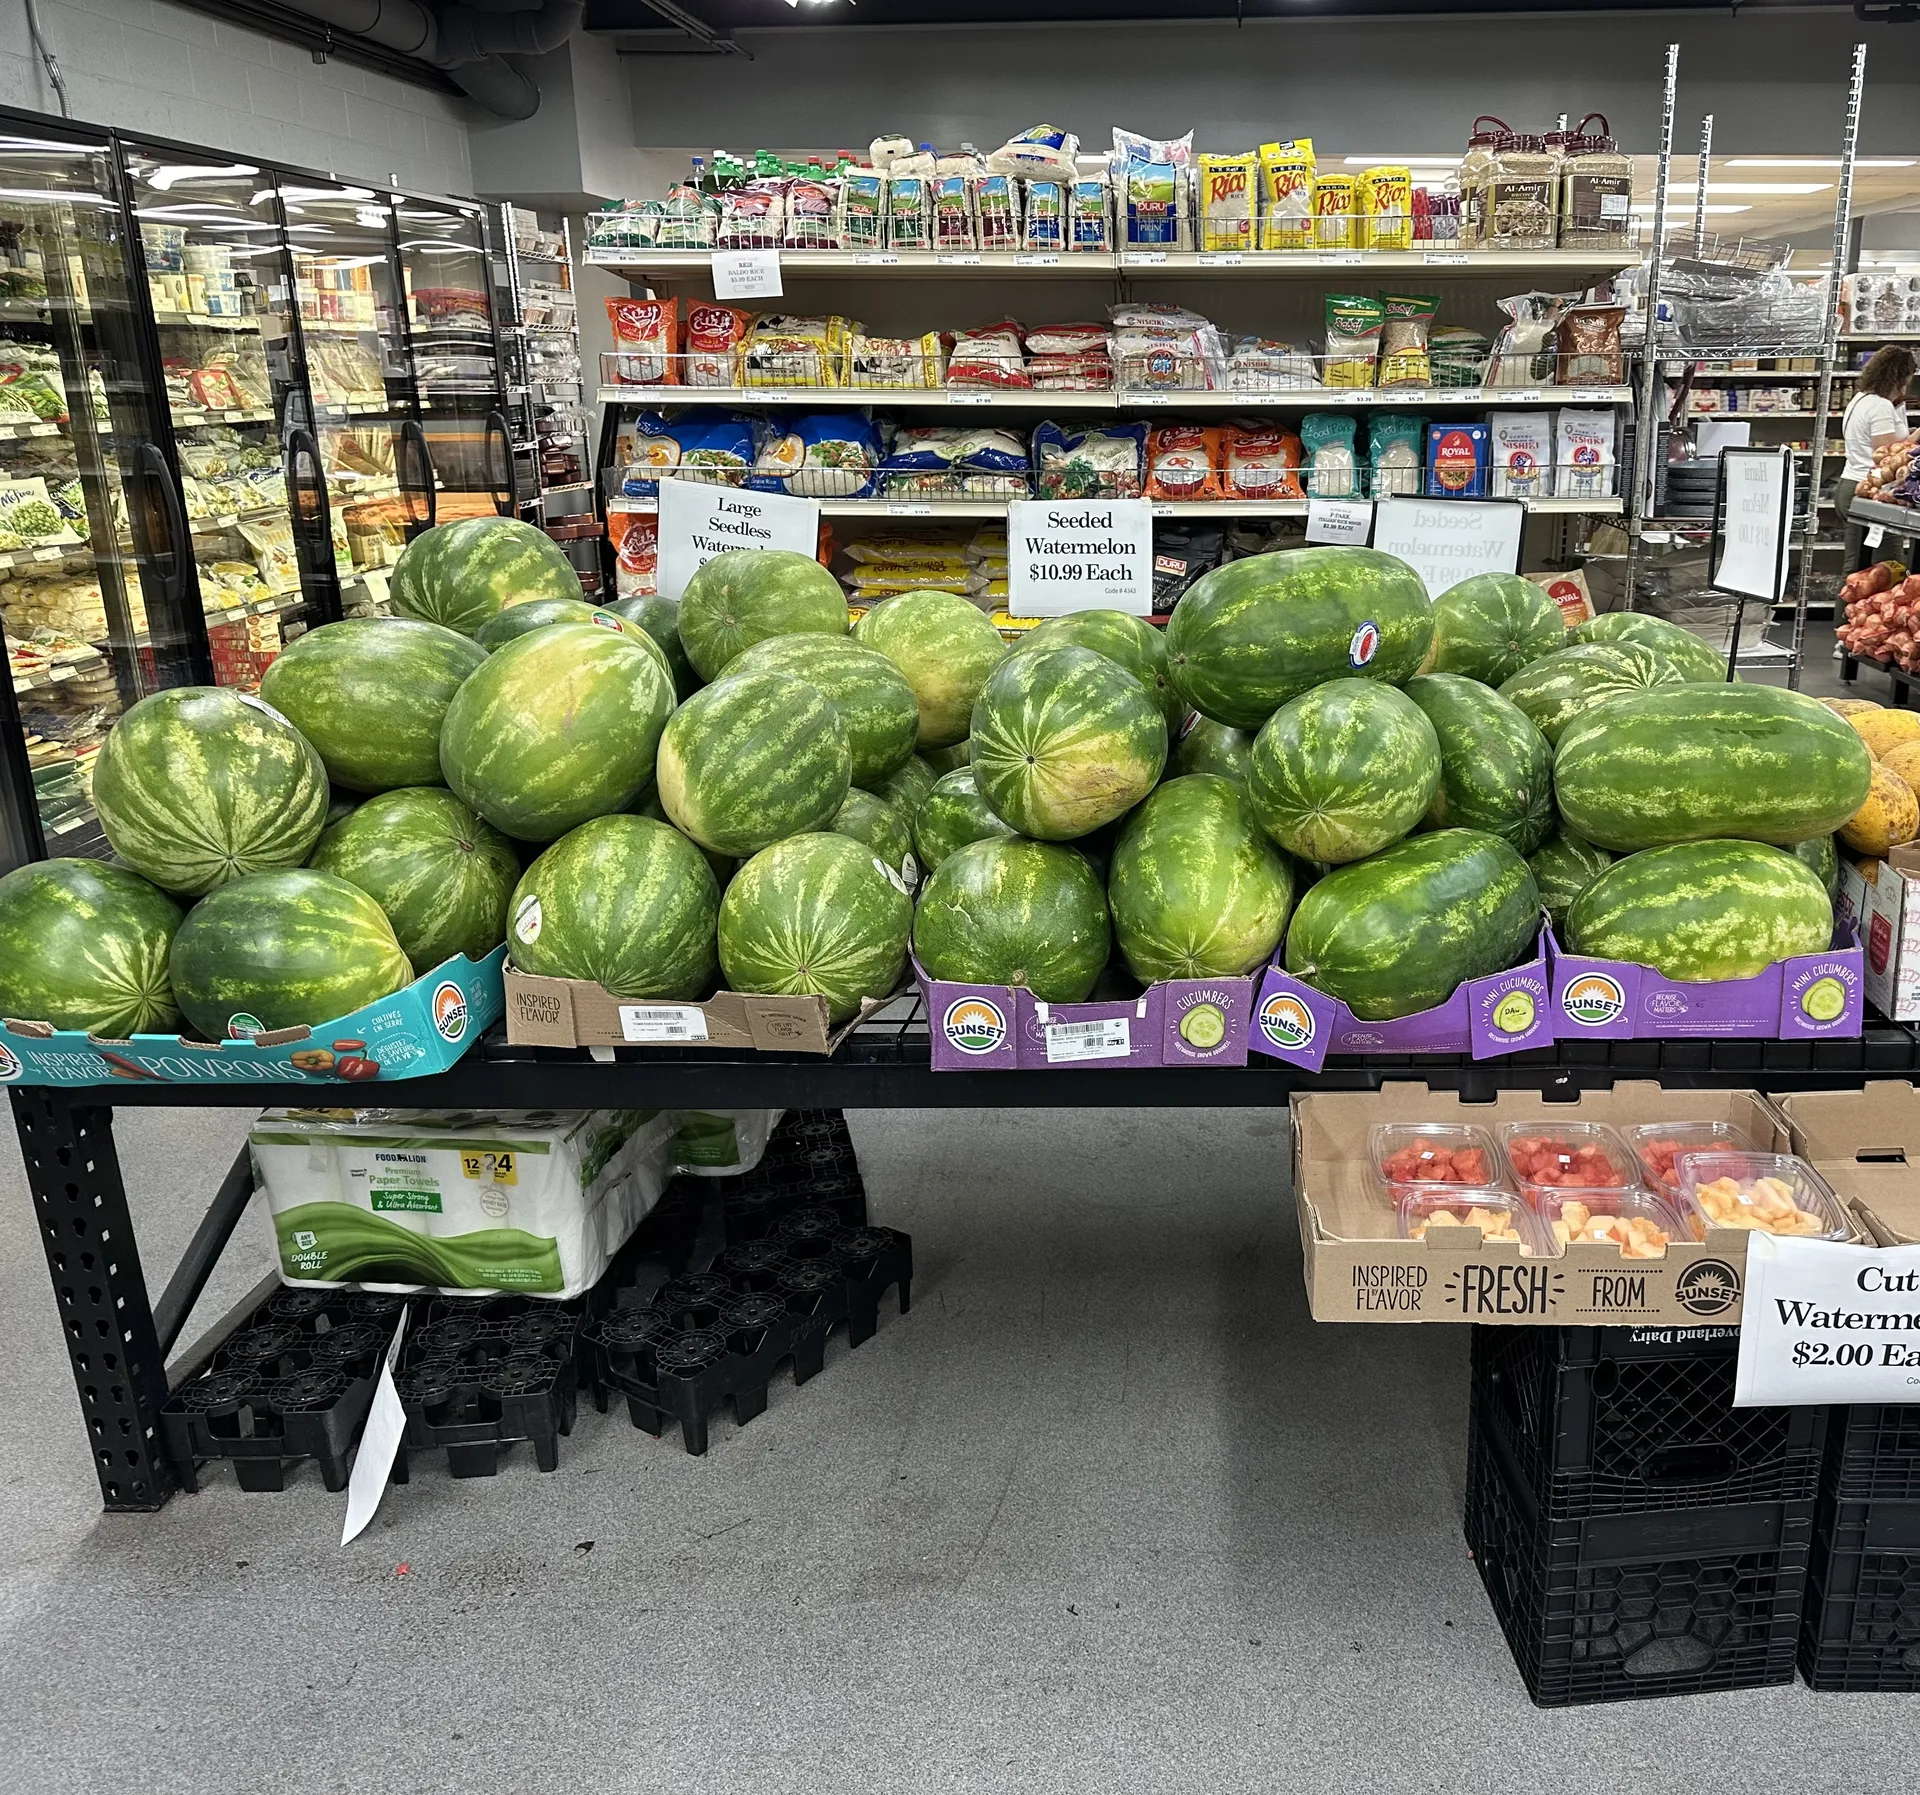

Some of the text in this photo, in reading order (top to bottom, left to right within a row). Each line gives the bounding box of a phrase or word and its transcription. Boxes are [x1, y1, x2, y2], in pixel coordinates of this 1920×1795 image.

[1210, 173, 1247, 203] Rico
[1374, 184, 1406, 209] Rico
[1504, 185, 1544, 193] Al-Amir
[853, 205, 873, 214] DURU
[1138, 202, 1165, 212] DURU
[1319, 192, 1351, 215] Rico
[1136, 318, 1165, 326] NISHIKI
[1568, 436, 1605, 445] NISHIKI
[1441, 447, 1471, 457] ROYAL
[717, 496, 762, 519] Large
[708, 516, 772, 540] Seedless
[1047, 511, 1113, 528] Seeded
[1025, 537, 1137, 555] Watermelon
[1158, 557, 1185, 571] DURU
[1029, 563, 1083, 583] $10.99
[1085, 563, 1133, 581] Each
[1791, 963, 1858, 991] MINI CUCUMBERS
[516, 991, 561, 1010] INSPIRED
[1177, 990, 1235, 1011] CUCUMBERS
[1482, 976, 1545, 1008] MINI CUCUMBERS
[1563, 998, 1621, 1014] SUNSET
[438, 1003, 468, 1035] SUNSET
[520, 1006, 561, 1024] FLAVOR
[1794, 1015, 1816, 1030] GREENHOUSE
[1830, 1010, 1851, 1029] GOODNESS
[373, 1017, 404, 1033] EN SERRE
[946, 1023, 1005, 1040] SUNSET
[1259, 1013, 1312, 1045] SUNSET
[1487, 1019, 1542, 1043] GREENHOUSE GROWN GOODNESS
[26, 1050, 106, 1067] INSPIRED
[375, 1043, 415, 1063] LES SAVEURS
[383, 1050, 412, 1066] DE LA VIE
[43, 1065, 115, 1080] FLAVOR
[138, 1055, 307, 1080] POIVRONS
[375, 1153, 427, 1163] FOOD LION
[464, 1158, 480, 1169] 12
[484, 1153, 513, 1172] 24
[385, 1166, 421, 1175] Premium
[369, 1174, 440, 1187] Paper Towels
[377, 1200, 439, 1210] & Ultra Absorbent
[383, 1192, 430, 1204] Super Strong
[300, 1233, 312, 1242] ANY
[300, 1239, 314, 1247] SIZE
[290, 1251, 328, 1263] DOUBLE
[300, 1259, 323, 1270] ROLL
[1352, 1265, 1428, 1288] INSPIRED
[1857, 1266, 1919, 1292] Cut
[1462, 1264, 1548, 1315] FRESH
[1592, 1276, 1646, 1308] FROM
[1675, 1288, 1741, 1304] SUNSET
[1356, 1287, 1422, 1311] FLAVOR
[1629, 1329, 1673, 1345] Dairy
[1792, 1341, 1874, 1368] $2.00
